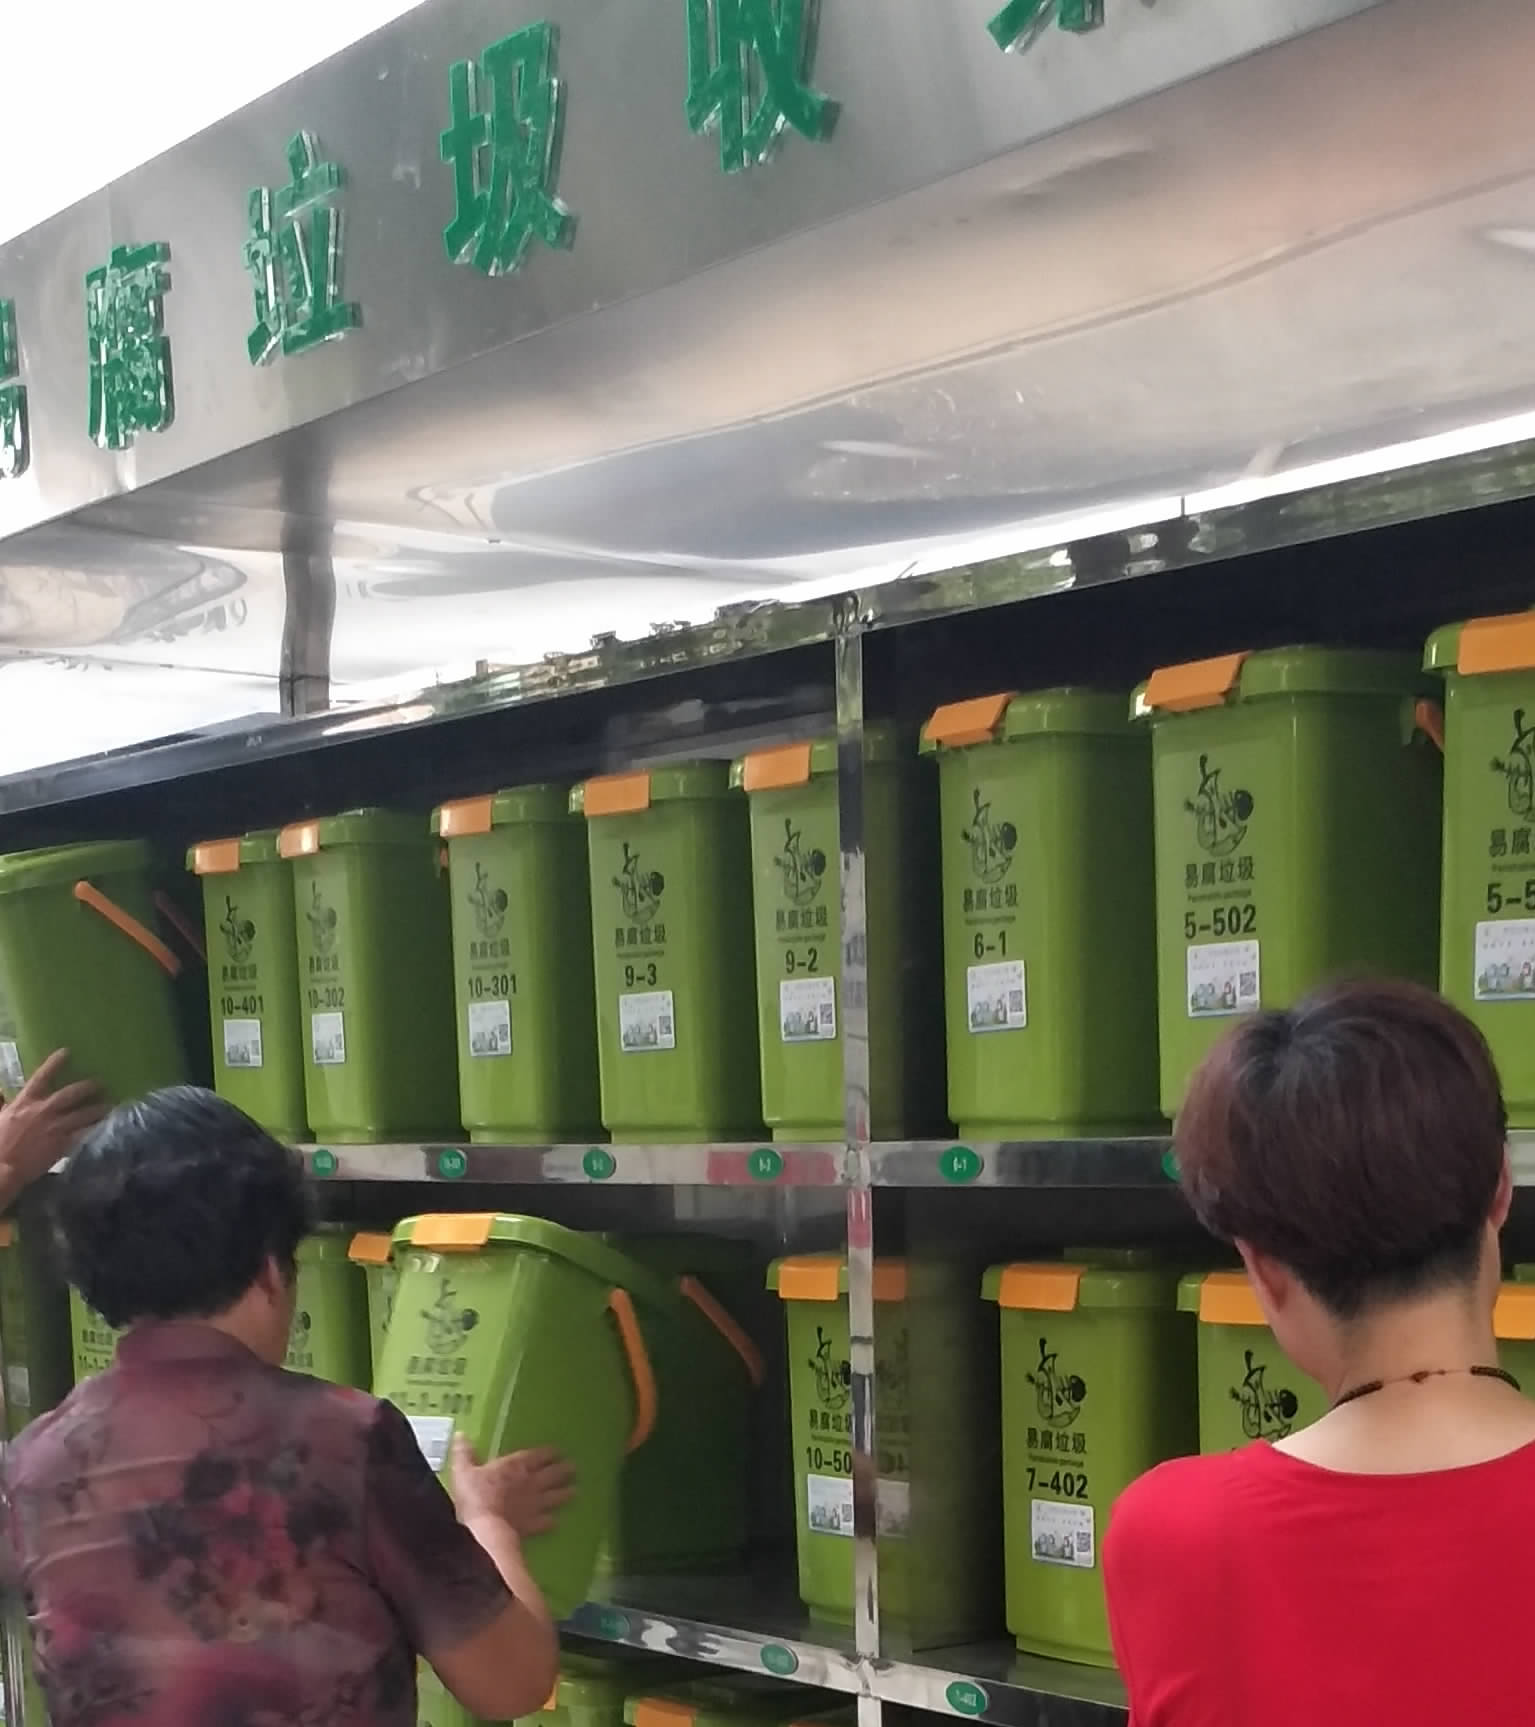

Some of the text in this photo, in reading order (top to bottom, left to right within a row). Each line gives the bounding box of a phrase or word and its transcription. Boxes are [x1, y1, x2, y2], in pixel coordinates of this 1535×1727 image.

[1185, 856, 1255, 888] 易腐垃圾
[963, 884, 1018, 912] 易腐垃圾
[776, 905, 827, 930] 易腐垃圾
[1185, 904, 1257, 939] 5-502
[975, 930, 1006, 959] 6-1
[785, 948, 818, 973] 9-2
[468, 974, 517, 998] 10-301
[625, 964, 657, 986] 9-3
[221, 996, 264, 1015] 10-401
[1027, 1427, 1087, 1454] 易腐垃圾
[806, 1447, 852, 1473] 10-50
[1026, 1467, 1088, 1499] 7-402
